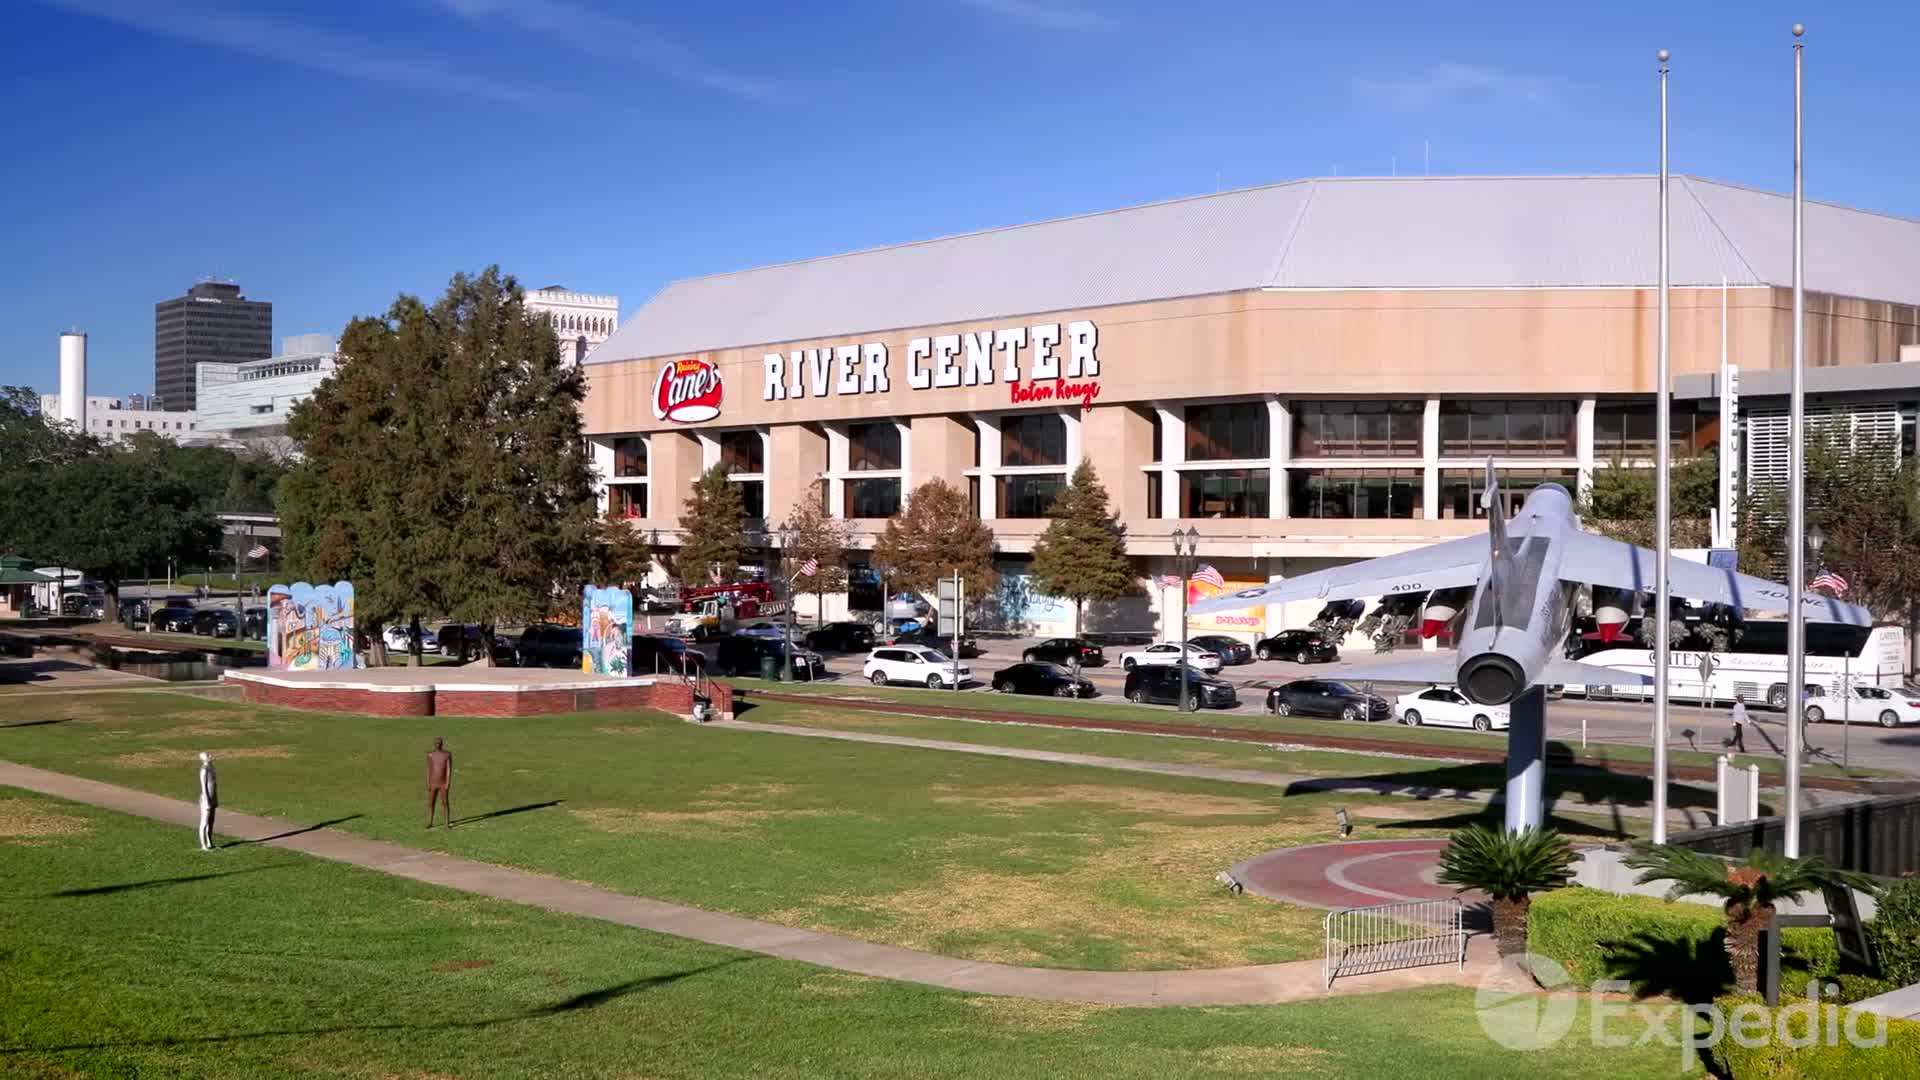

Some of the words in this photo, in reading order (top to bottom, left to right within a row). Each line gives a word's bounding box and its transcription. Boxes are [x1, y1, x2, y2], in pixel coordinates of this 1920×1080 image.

[762, 342, 890, 401] RIVER
[906, 319, 1101, 391] CENTER
[1011, 381, 1052, 404] Baton
[1056, 378, 1101, 413] Rouge
[1391, 583, 1422, 592] 400
